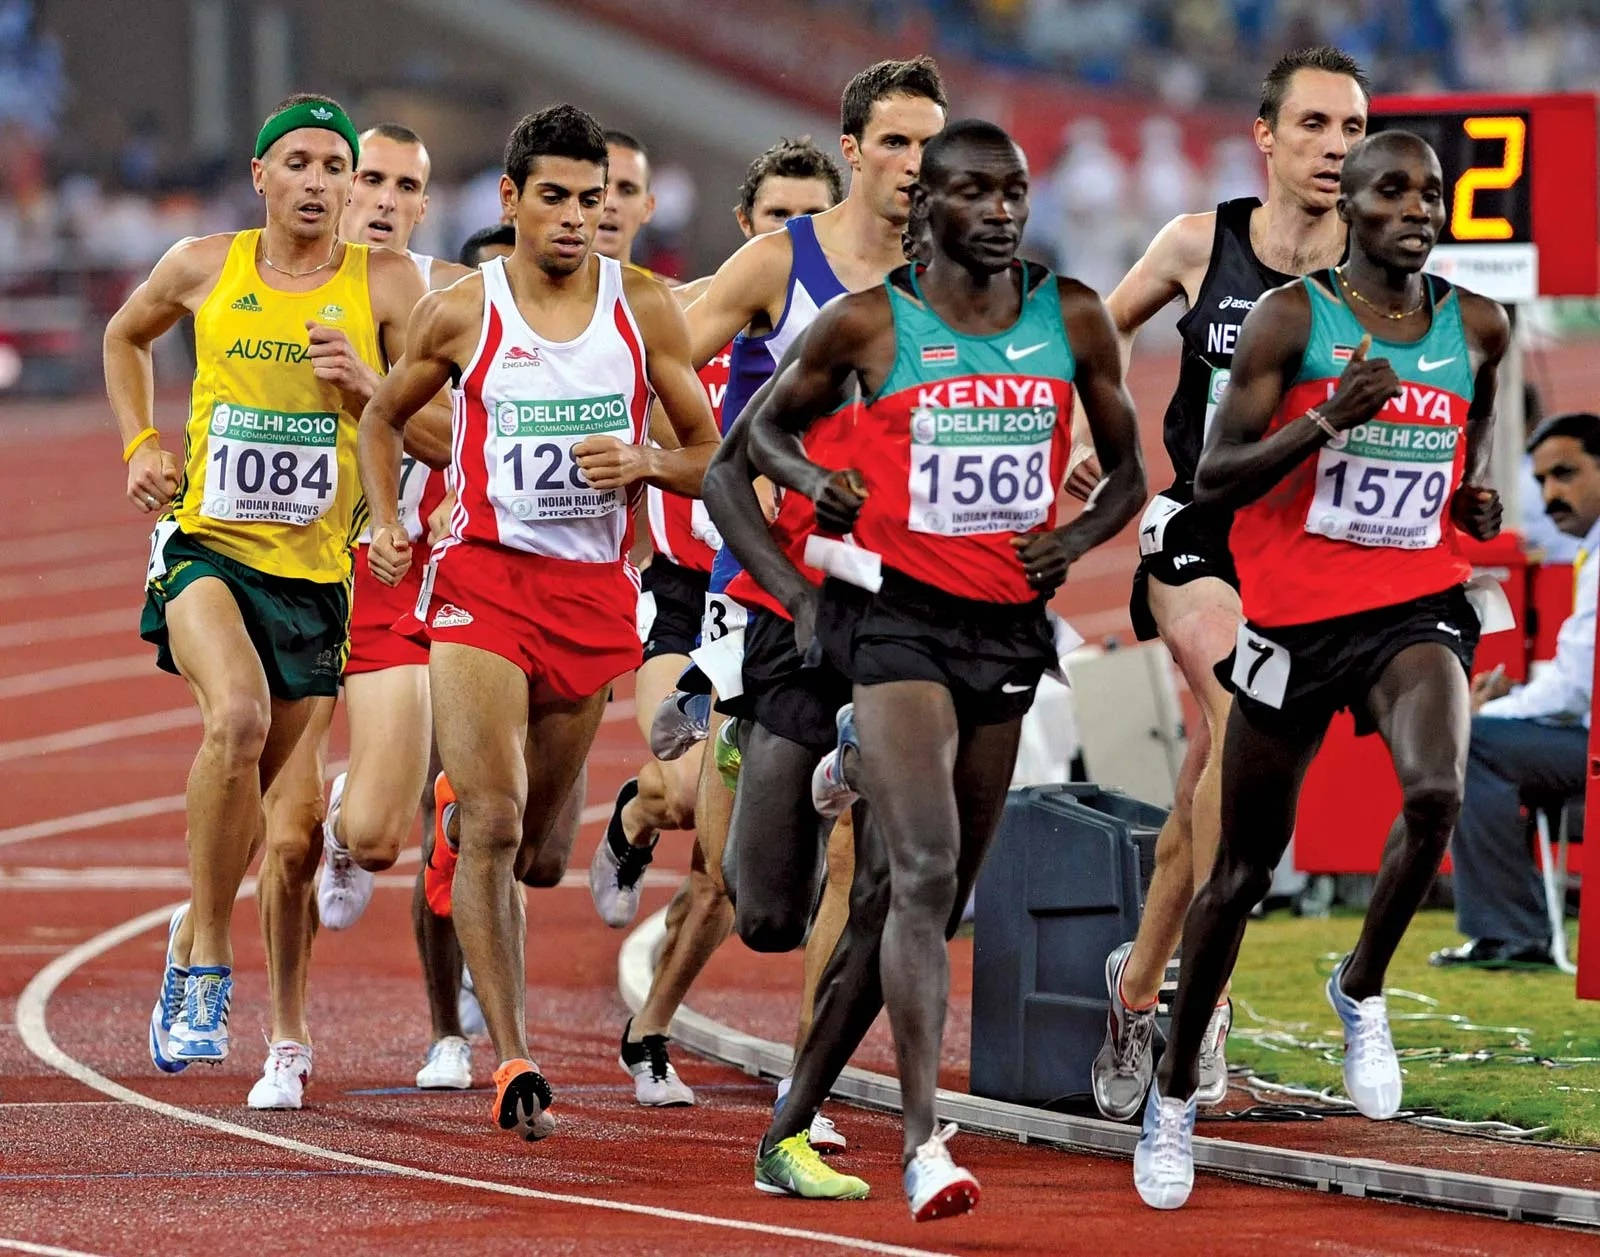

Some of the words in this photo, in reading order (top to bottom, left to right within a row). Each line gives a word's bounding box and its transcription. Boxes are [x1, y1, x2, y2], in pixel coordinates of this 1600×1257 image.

[1451, 116, 1526, 240] 2
[231, 302, 262, 312] adidas
[1207, 322, 1242, 355] NE
[502, 361, 541, 369] ENGLAND
[918, 379, 1056, 408] KENYA
[230, 409, 283, 432] DELHI
[286, 417, 336, 434] 2010
[520, 405, 575, 423] DELHI
[580, 400, 625, 421] 2010
[936, 413, 1000, 433] DELHI
[1003, 411, 1056, 433] 2010
[228, 428, 241, 436] XIX
[241, 431, 311, 443] COMMONWEALTH
[311, 436, 335, 444] GAMES
[520, 425, 533, 433] XIX
[535, 423, 603, 433] COMMONWEALTH
[604, 418, 628, 428] GAMES
[1350, 424, 1410, 448] DELHI
[1412, 430, 1458, 450] 2010
[212, 444, 332, 499] 1084
[919, 451, 1044, 505] 1568
[537, 495, 573, 507] INDIAN
[574, 489, 616, 506] RAILWAYS
[1324, 460, 1446, 519] 1579
[236, 499, 270, 511] INDIAN
[271, 501, 320, 516] RAILWAYS
[952, 511, 988, 523] INDIAN
[1348, 521, 1385, 535] INDIAN
[709, 599, 729, 642] 3
[1247, 637, 1275, 690] 7
